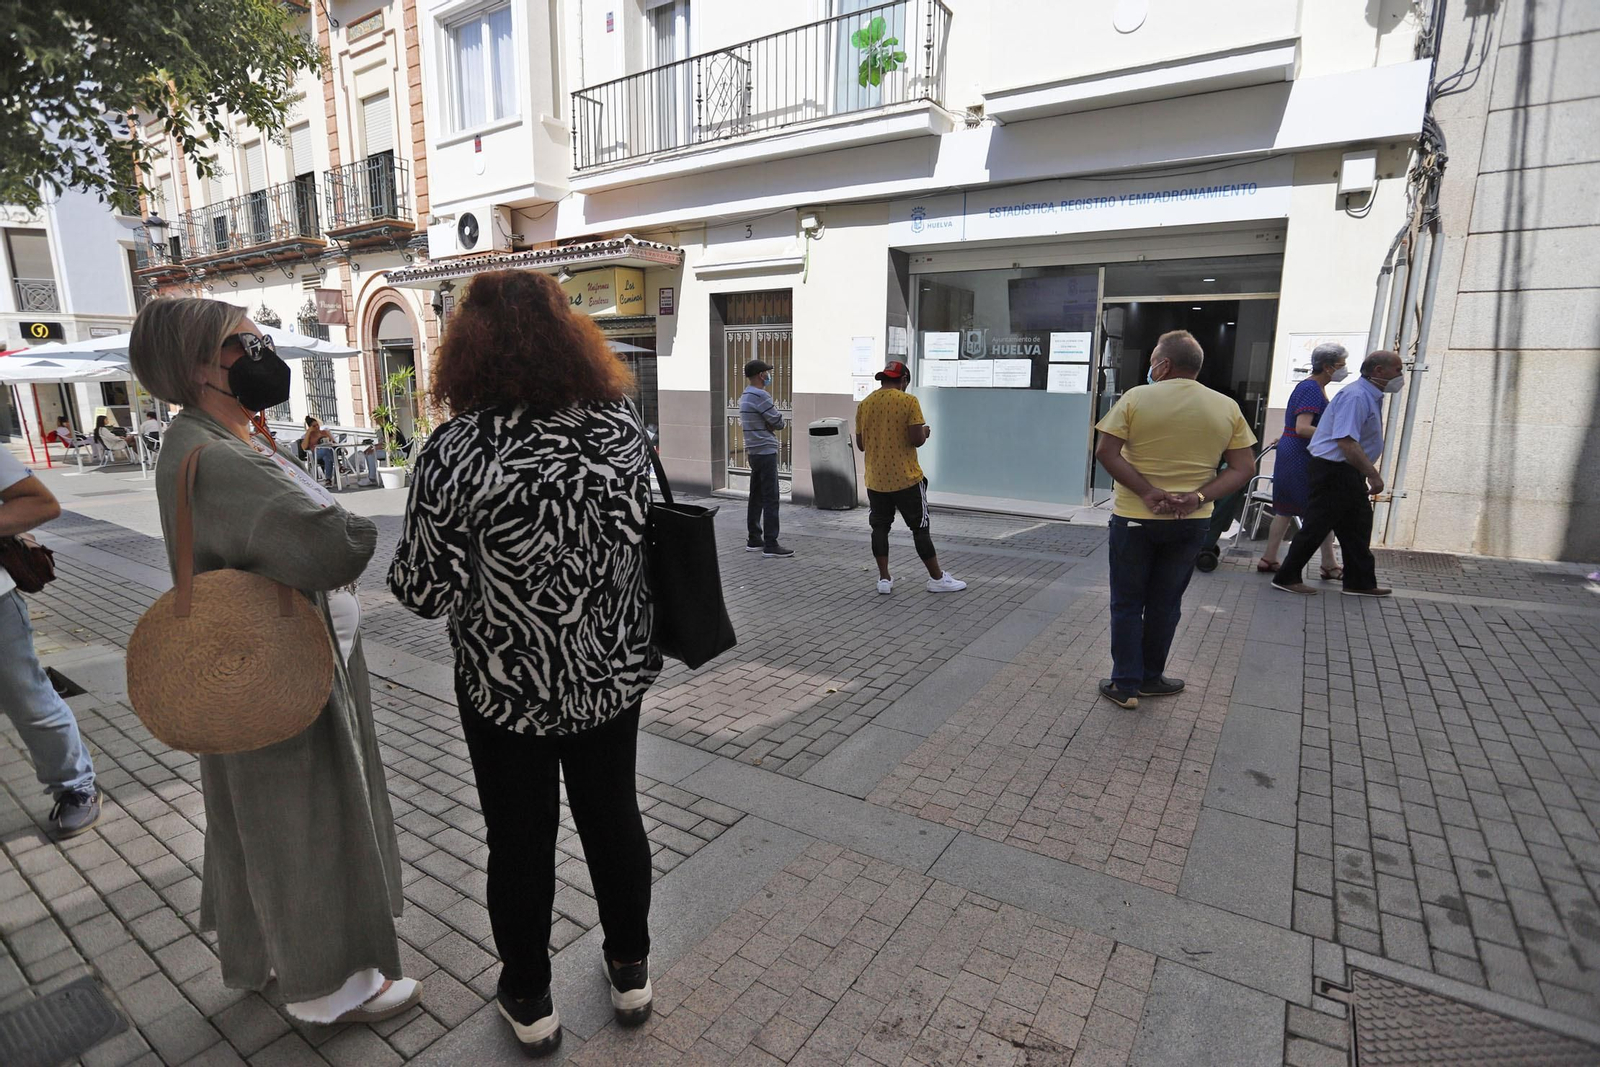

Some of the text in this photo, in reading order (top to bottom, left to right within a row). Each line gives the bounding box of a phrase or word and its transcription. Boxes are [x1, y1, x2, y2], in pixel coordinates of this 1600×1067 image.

[989, 182, 1258, 218] ESTADÍSTICA, REGISTRO Y EMPADRONAMIENTO
[926, 221, 953, 229] HUELVA
[745, 224, 753, 239] 3
[624, 279, 635, 291] Los
[992, 336, 1032, 344] Ayuntamiento
[991, 344, 1042, 355] HUELVA
